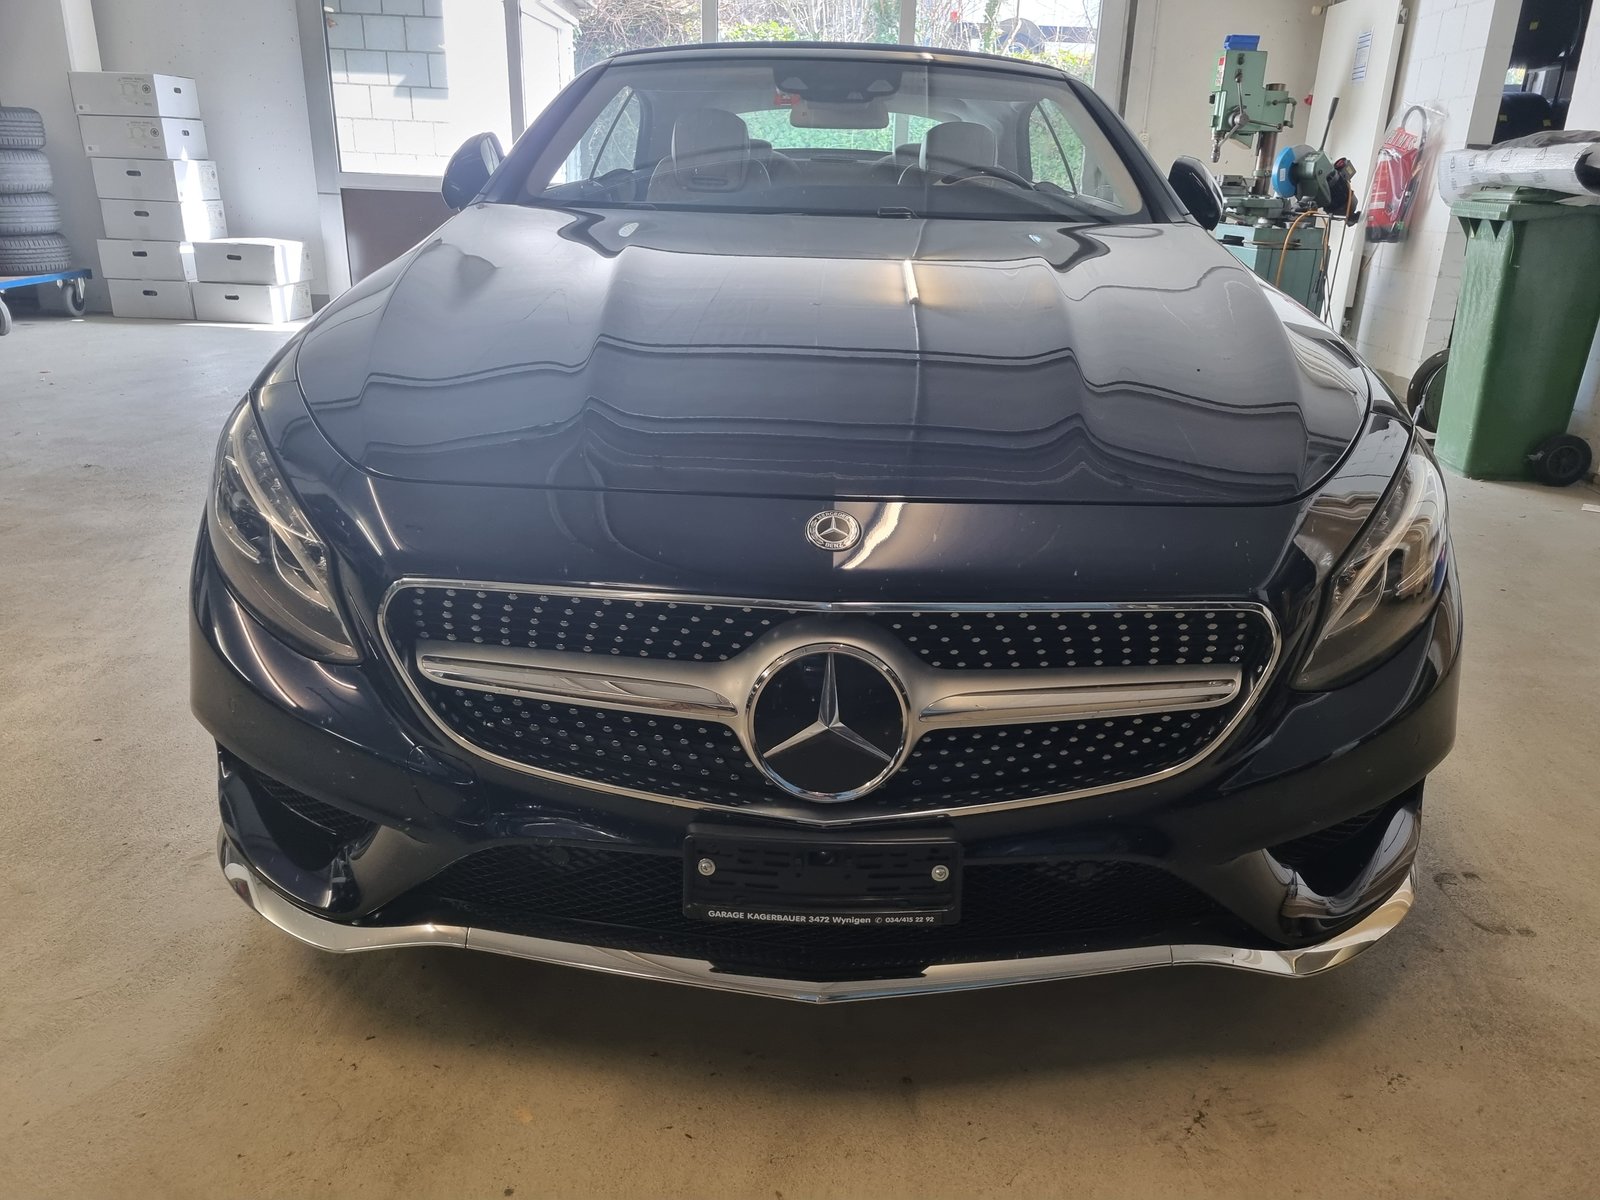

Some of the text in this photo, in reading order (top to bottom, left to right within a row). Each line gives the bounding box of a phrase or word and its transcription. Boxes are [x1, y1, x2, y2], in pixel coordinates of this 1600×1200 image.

[708, 910, 744, 919] GARAGE
[747, 912, 806, 922] KAGERBAUER
[808, 915, 830, 924] 3472
[832, 916, 871, 926] Wynigen
[885, 916, 913, 924] 034/415
